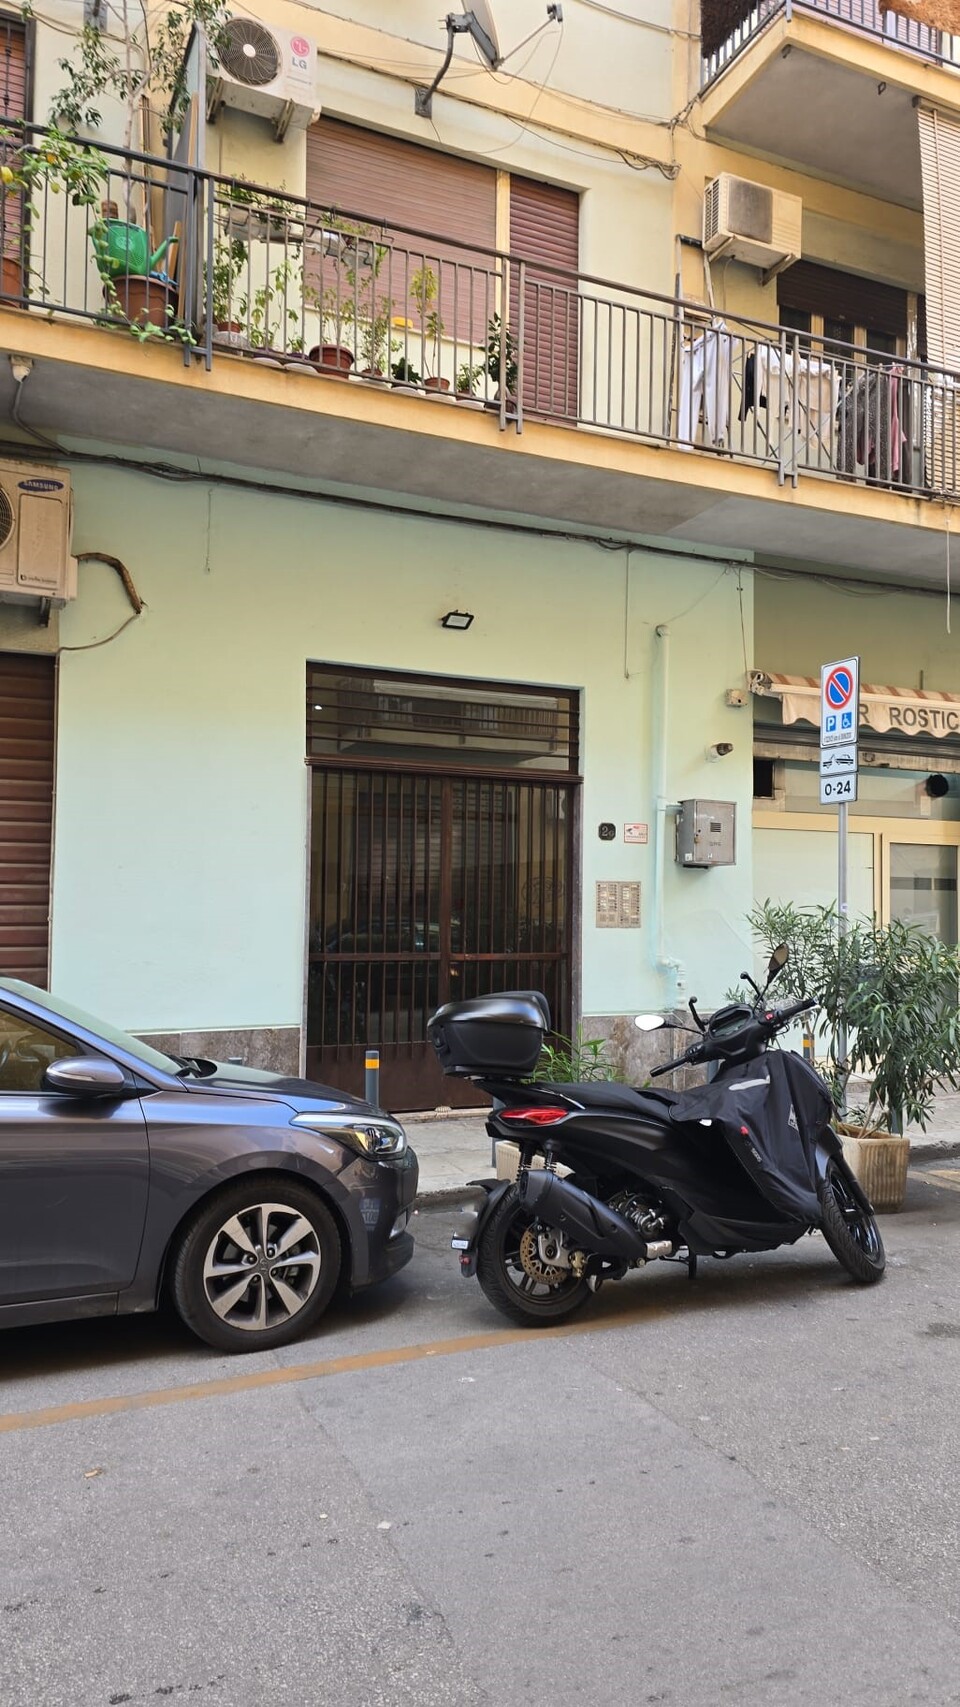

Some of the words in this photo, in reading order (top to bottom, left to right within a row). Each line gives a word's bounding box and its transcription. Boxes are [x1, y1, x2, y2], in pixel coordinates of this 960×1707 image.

[292, 56, 307, 70] LG
[889, 707, 959, 730] ROSTIC
[825, 780, 851, 796] 0-24
